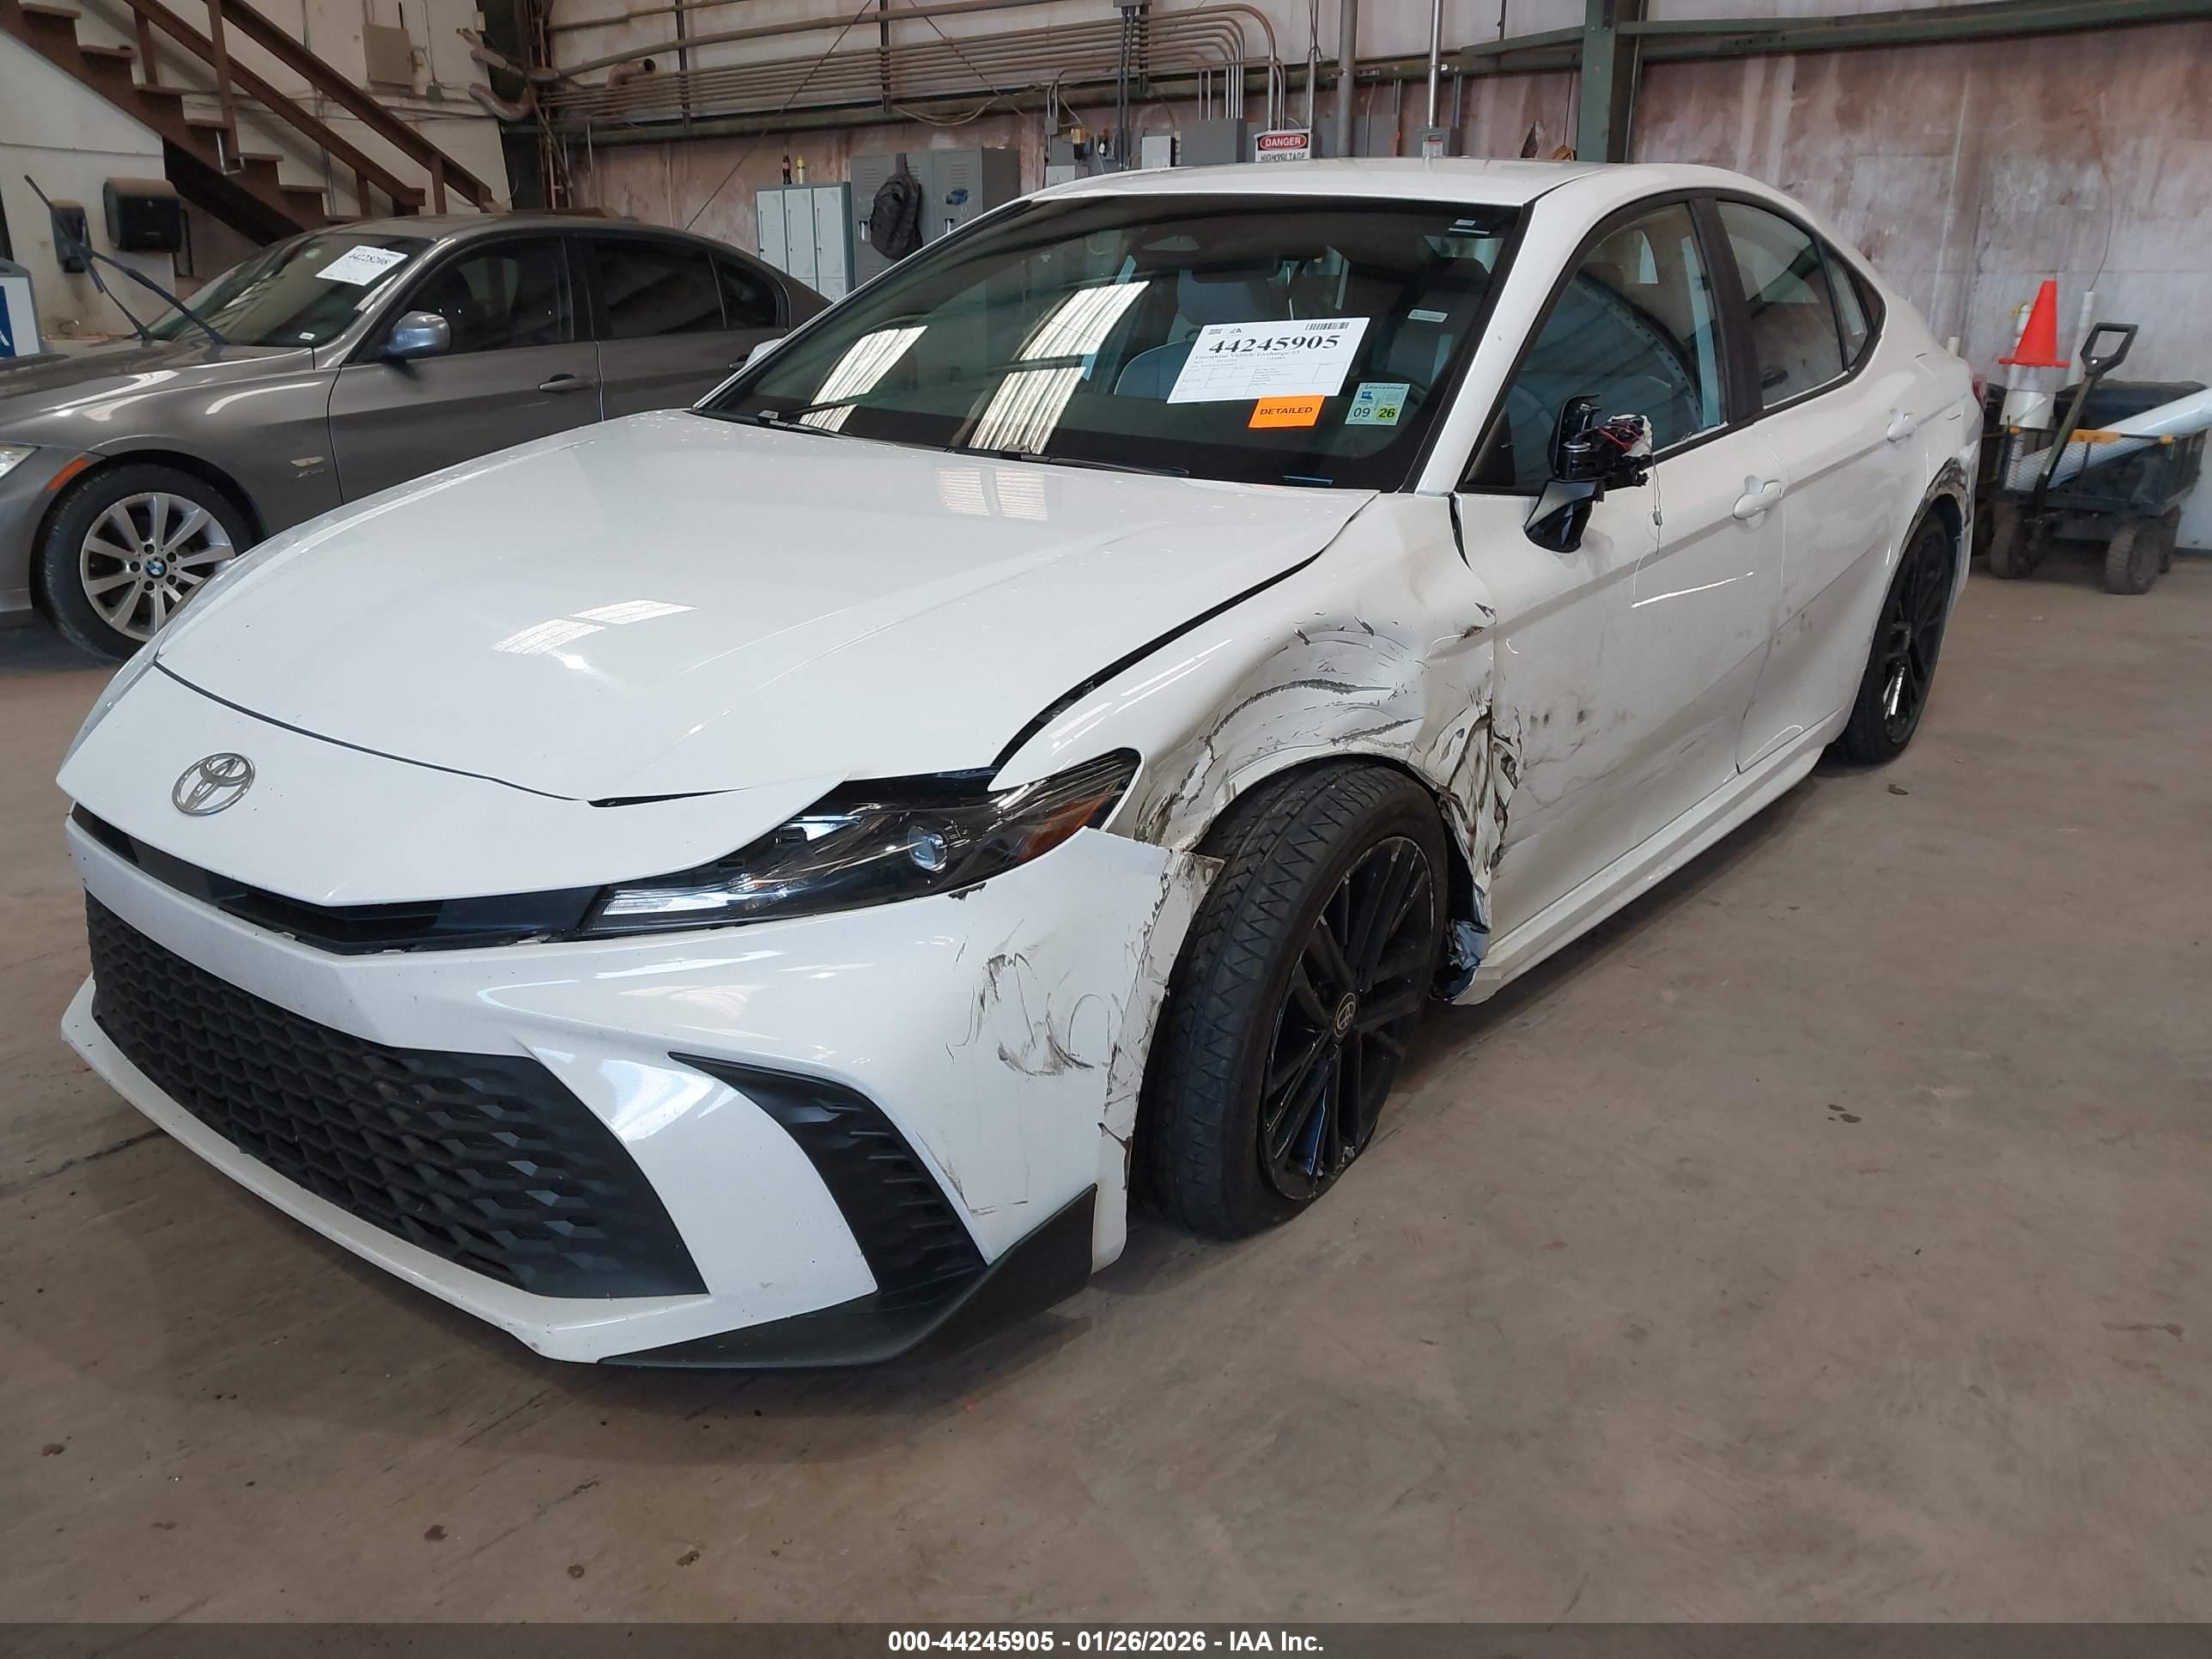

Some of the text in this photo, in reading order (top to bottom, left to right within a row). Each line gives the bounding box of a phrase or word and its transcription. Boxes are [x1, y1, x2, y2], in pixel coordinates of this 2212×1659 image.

[1265, 137, 1301, 147] DANGER
[1208, 335, 1341, 354] 44245905
[1260, 406, 1313, 416] DETAILED
[1353, 407, 1396, 418] 09 26
